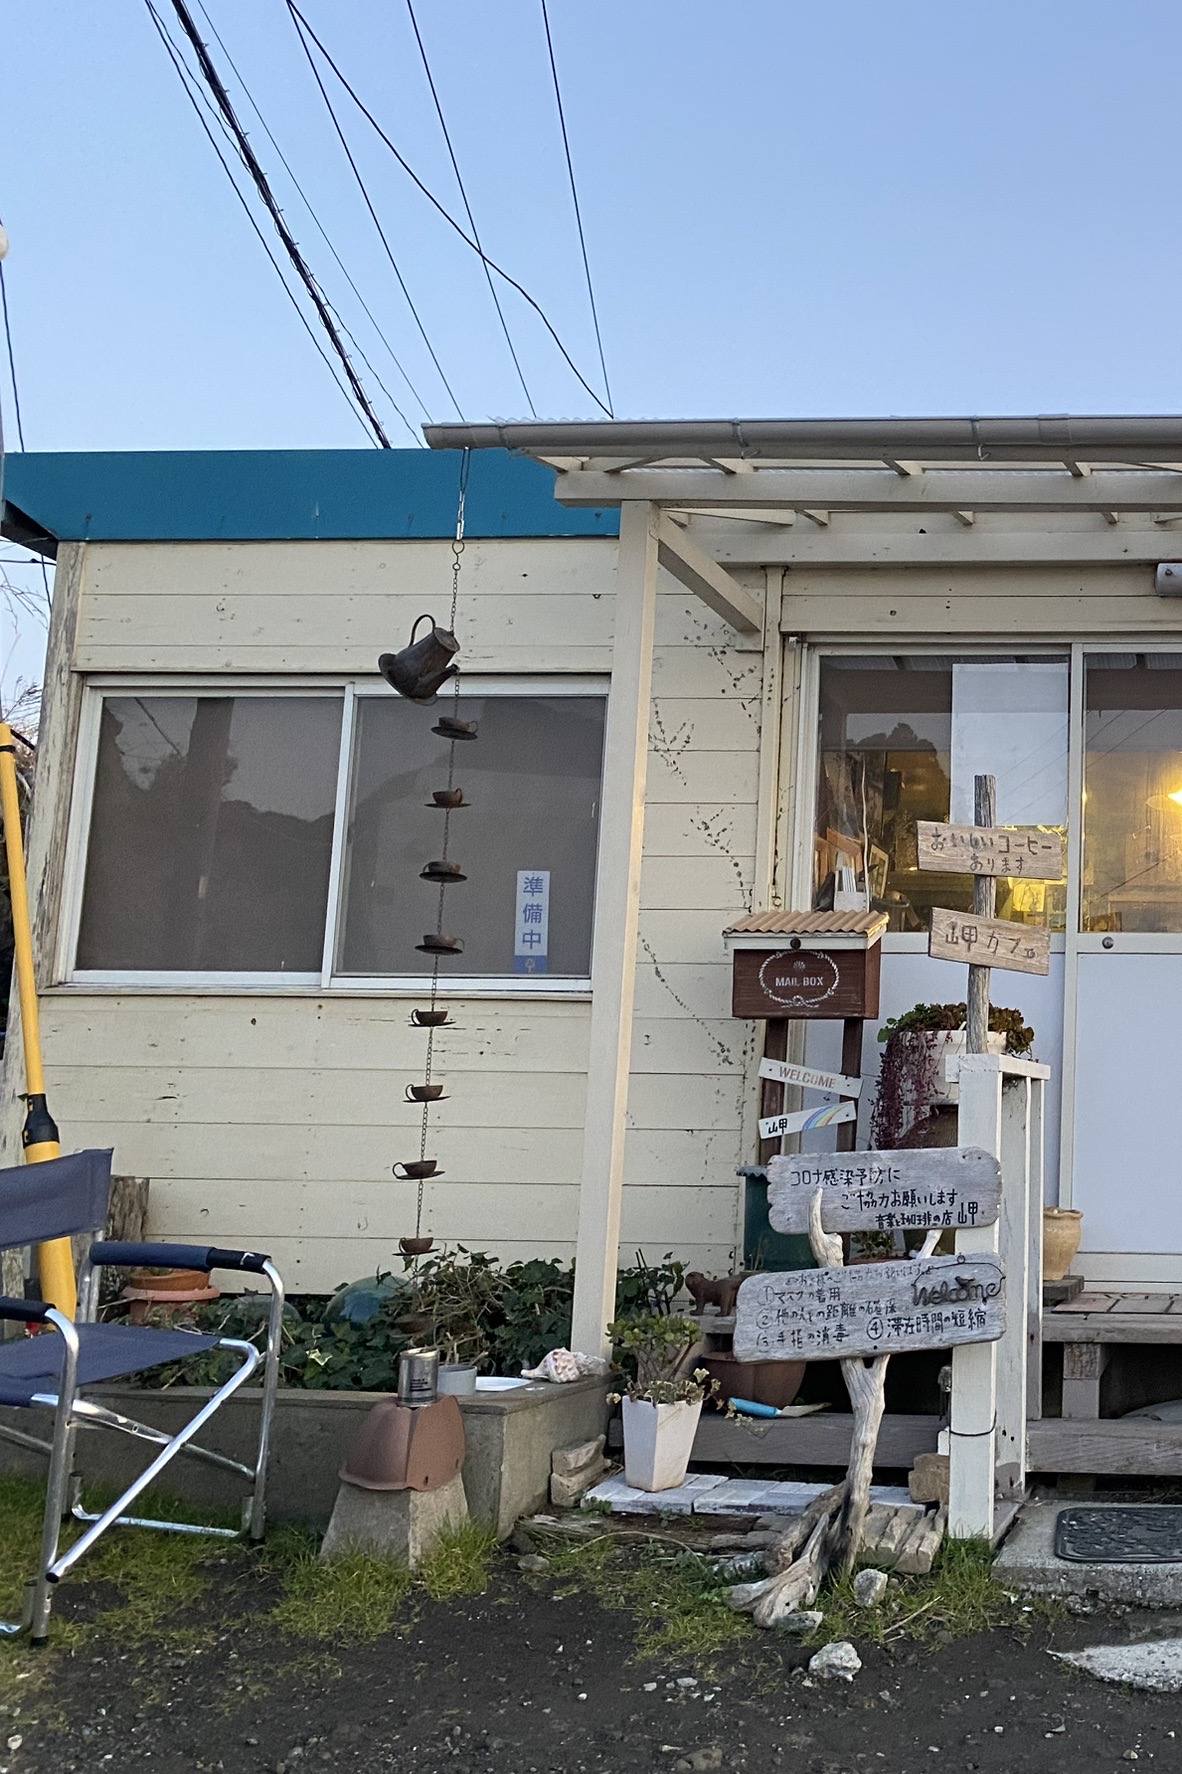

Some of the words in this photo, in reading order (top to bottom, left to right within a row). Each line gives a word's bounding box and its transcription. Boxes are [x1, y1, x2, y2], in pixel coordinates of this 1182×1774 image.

[930, 827, 1052, 856] おいしいコーヒー
[969, 852, 1025, 875] あります
[522, 876, 544, 950] 準備中
[775, 976, 801, 987] MAIL
[803, 976, 824, 987] BOX
[779, 1066, 837, 1089] WELCOME
[768, 1118, 788, 1135] 岬
[790, 1167, 901, 1187] コロナ感染予防に
[840, 1188, 959, 1212] ご協力お願いします
[957, 1201, 979, 1226] 岬
